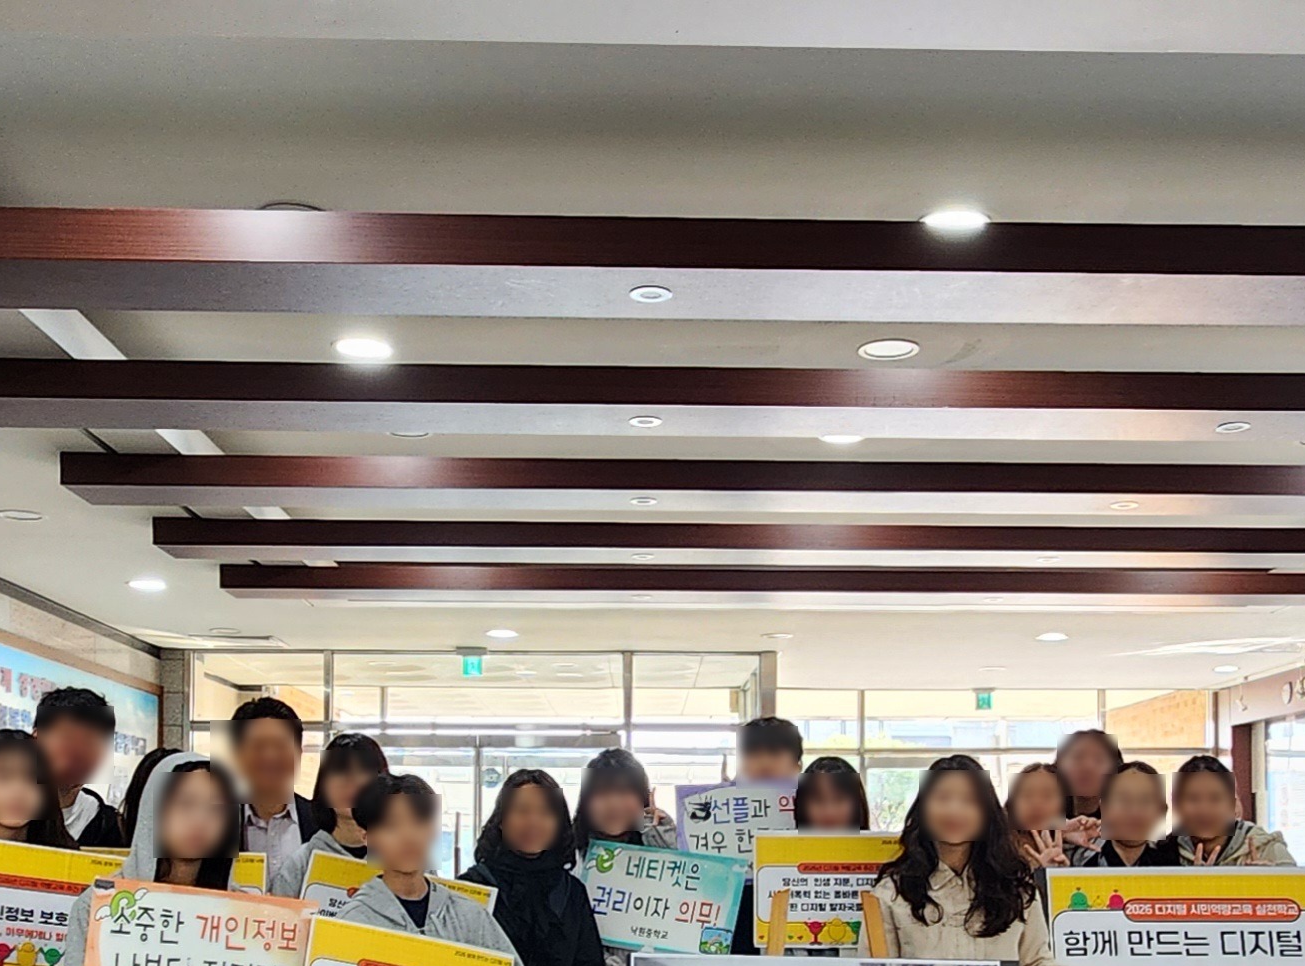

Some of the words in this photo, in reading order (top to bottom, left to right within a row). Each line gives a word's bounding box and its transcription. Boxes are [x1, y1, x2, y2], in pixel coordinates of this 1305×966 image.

[711, 796, 771, 825] 선플과
[688, 831, 728, 854] 겨우
[625, 855, 702, 891] 네티켓은
[781, 877, 809, 887] 당신의
[38, 909, 69, 927] 보호
[592, 886, 671, 919] 권리이자
[674, 900, 721, 929] 의무!
[800, 902, 827, 912] 디지털
[1126, 903, 1153, 915] 2026
[1154, 903, 1187, 916] 디지털
[110, 905, 185, 945] 소중한
[196, 914, 299, 952] 개인정보
[630, 925, 669, 940] 낙원중학교
[1063, 929, 1119, 958] 함께
[1127, 929, 1211, 958] 만드는
[1221, 929, 1304, 958] 디지털
